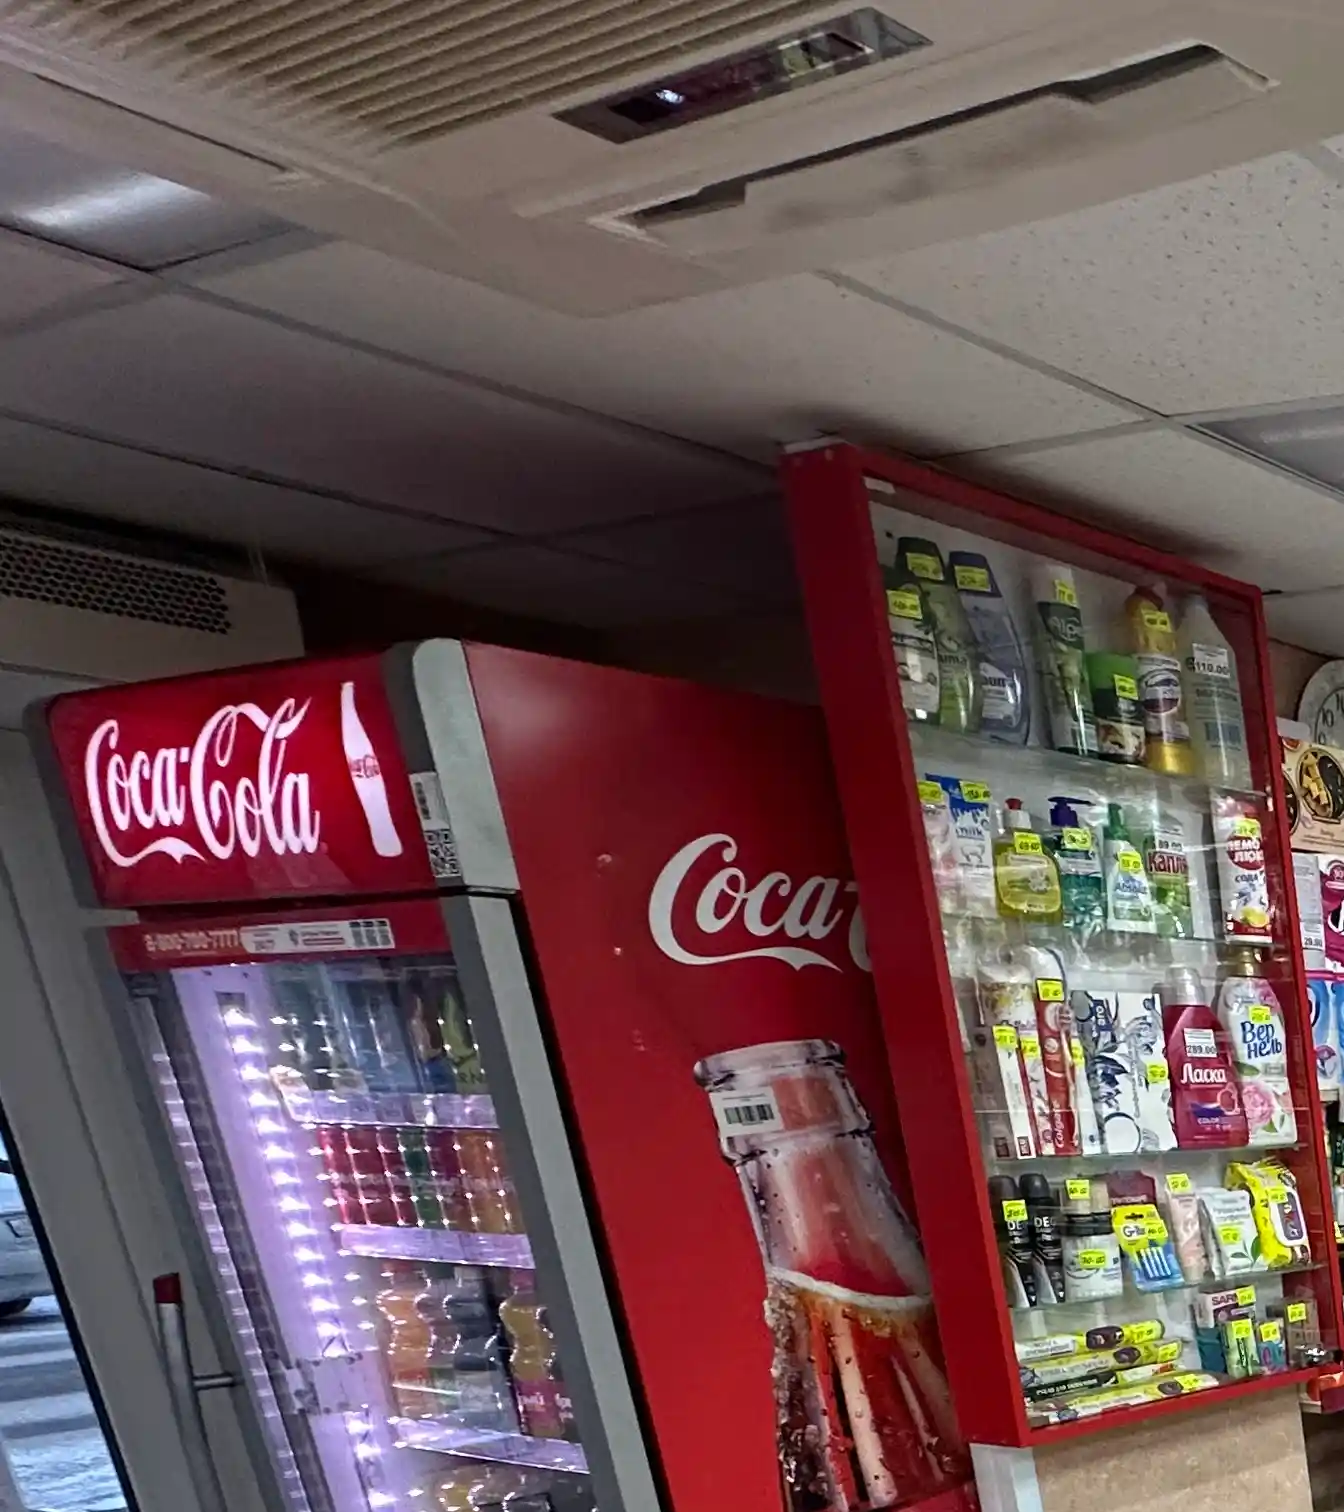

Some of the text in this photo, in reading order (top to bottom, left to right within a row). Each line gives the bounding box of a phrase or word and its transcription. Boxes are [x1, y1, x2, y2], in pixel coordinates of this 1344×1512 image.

[85, 696, 321, 869] Coca-Cola
[1240, 1021, 1275, 1052] Вер
[1180, 1064, 1228, 1086] Ласка
